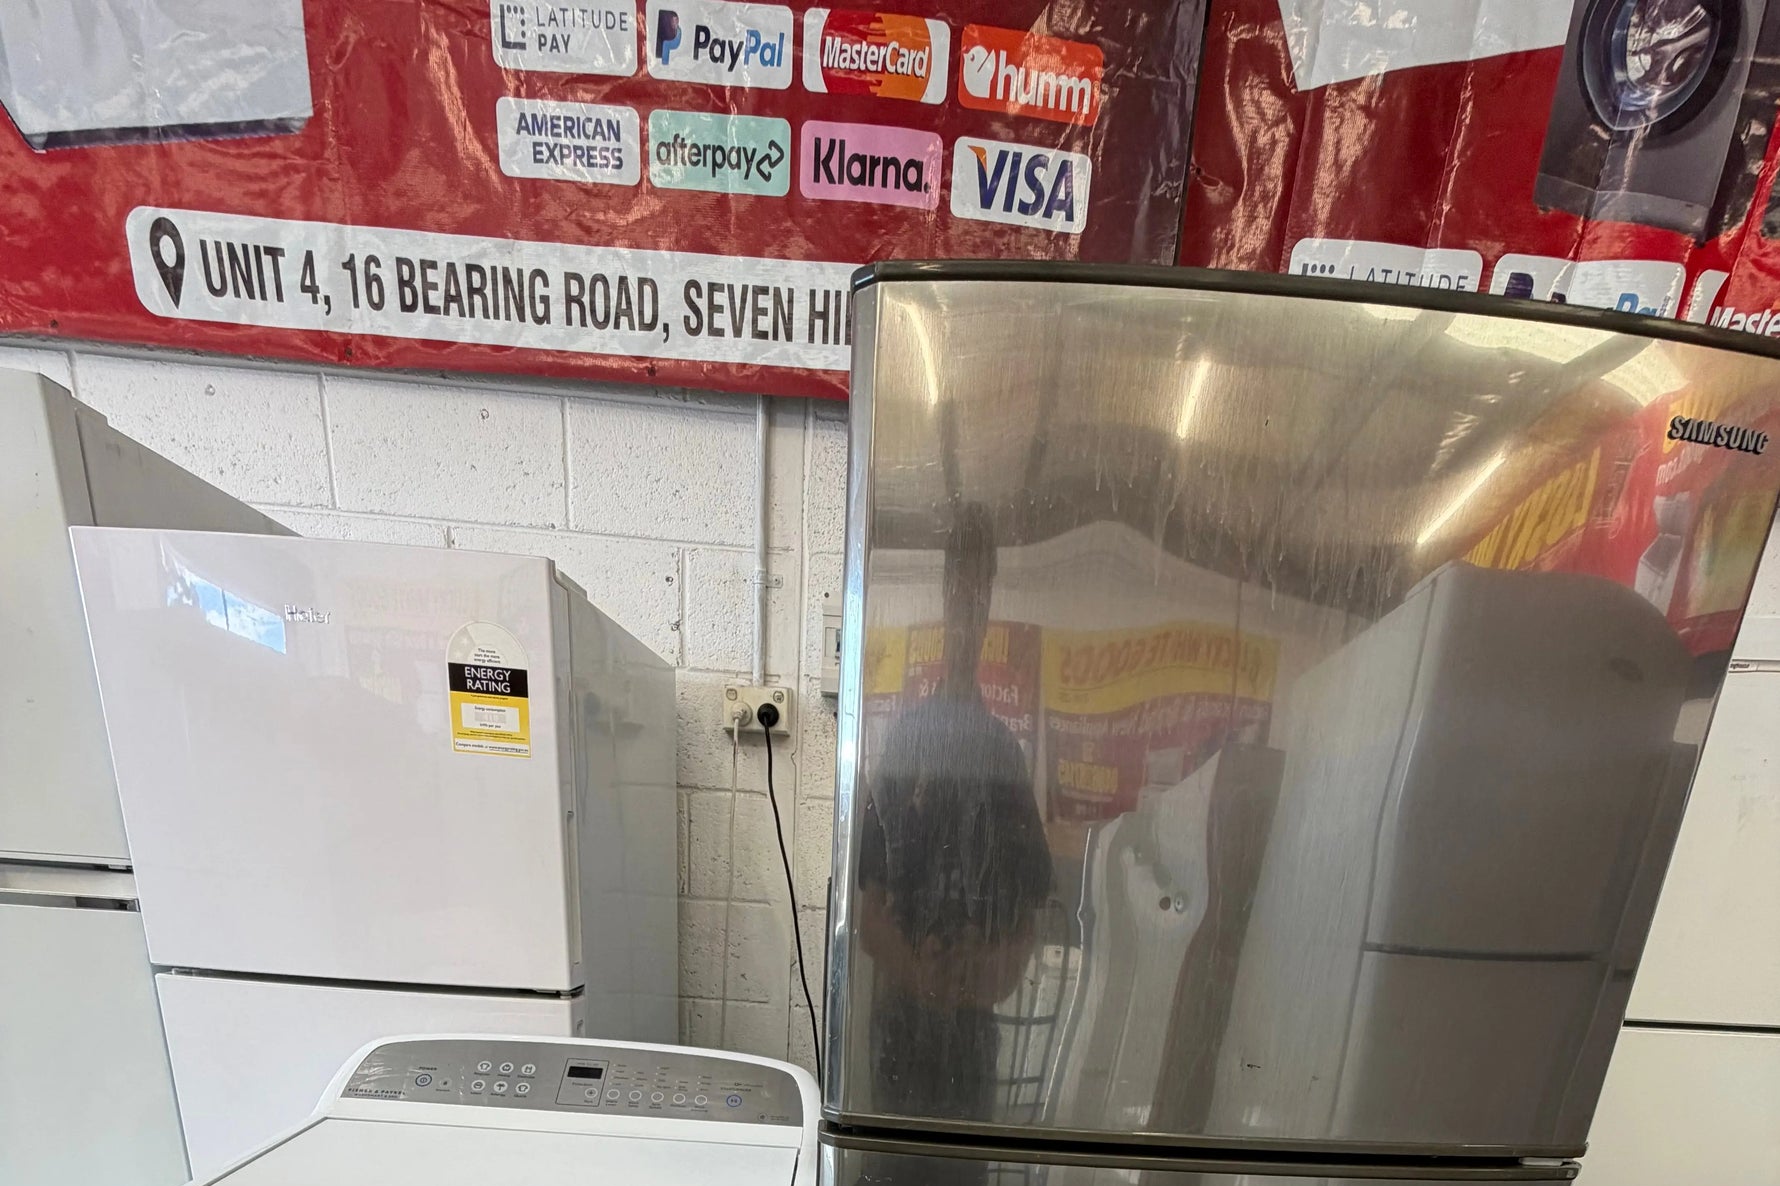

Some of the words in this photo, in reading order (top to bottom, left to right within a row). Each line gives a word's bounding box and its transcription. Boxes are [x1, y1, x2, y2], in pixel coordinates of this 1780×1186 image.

[535, 6, 629, 32] LATITUDE
[537, 34, 571, 54] PAY
[693, 24, 786, 72] PayPal
[821, 36, 930, 79] MasterCard
[996, 51, 1092, 115] humm
[516, 112, 621, 144] AMERICAN
[532, 141, 624, 170] EXPRESS
[656, 133, 757, 181] afterpay
[967, 145, 1076, 223] VISA
[199, 238, 286, 303] UNIT
[299, 249, 333, 317] 4,
[341, 252, 386, 312] 16
[395, 256, 552, 325] BEARING
[563, 271, 671, 344] ROAD,
[683, 279, 795, 343] SEVEN
[1667, 415, 1769, 455] SAMSUNG
[464, 666, 512, 681] ENERGY
[466, 679, 511, 693] RATING
